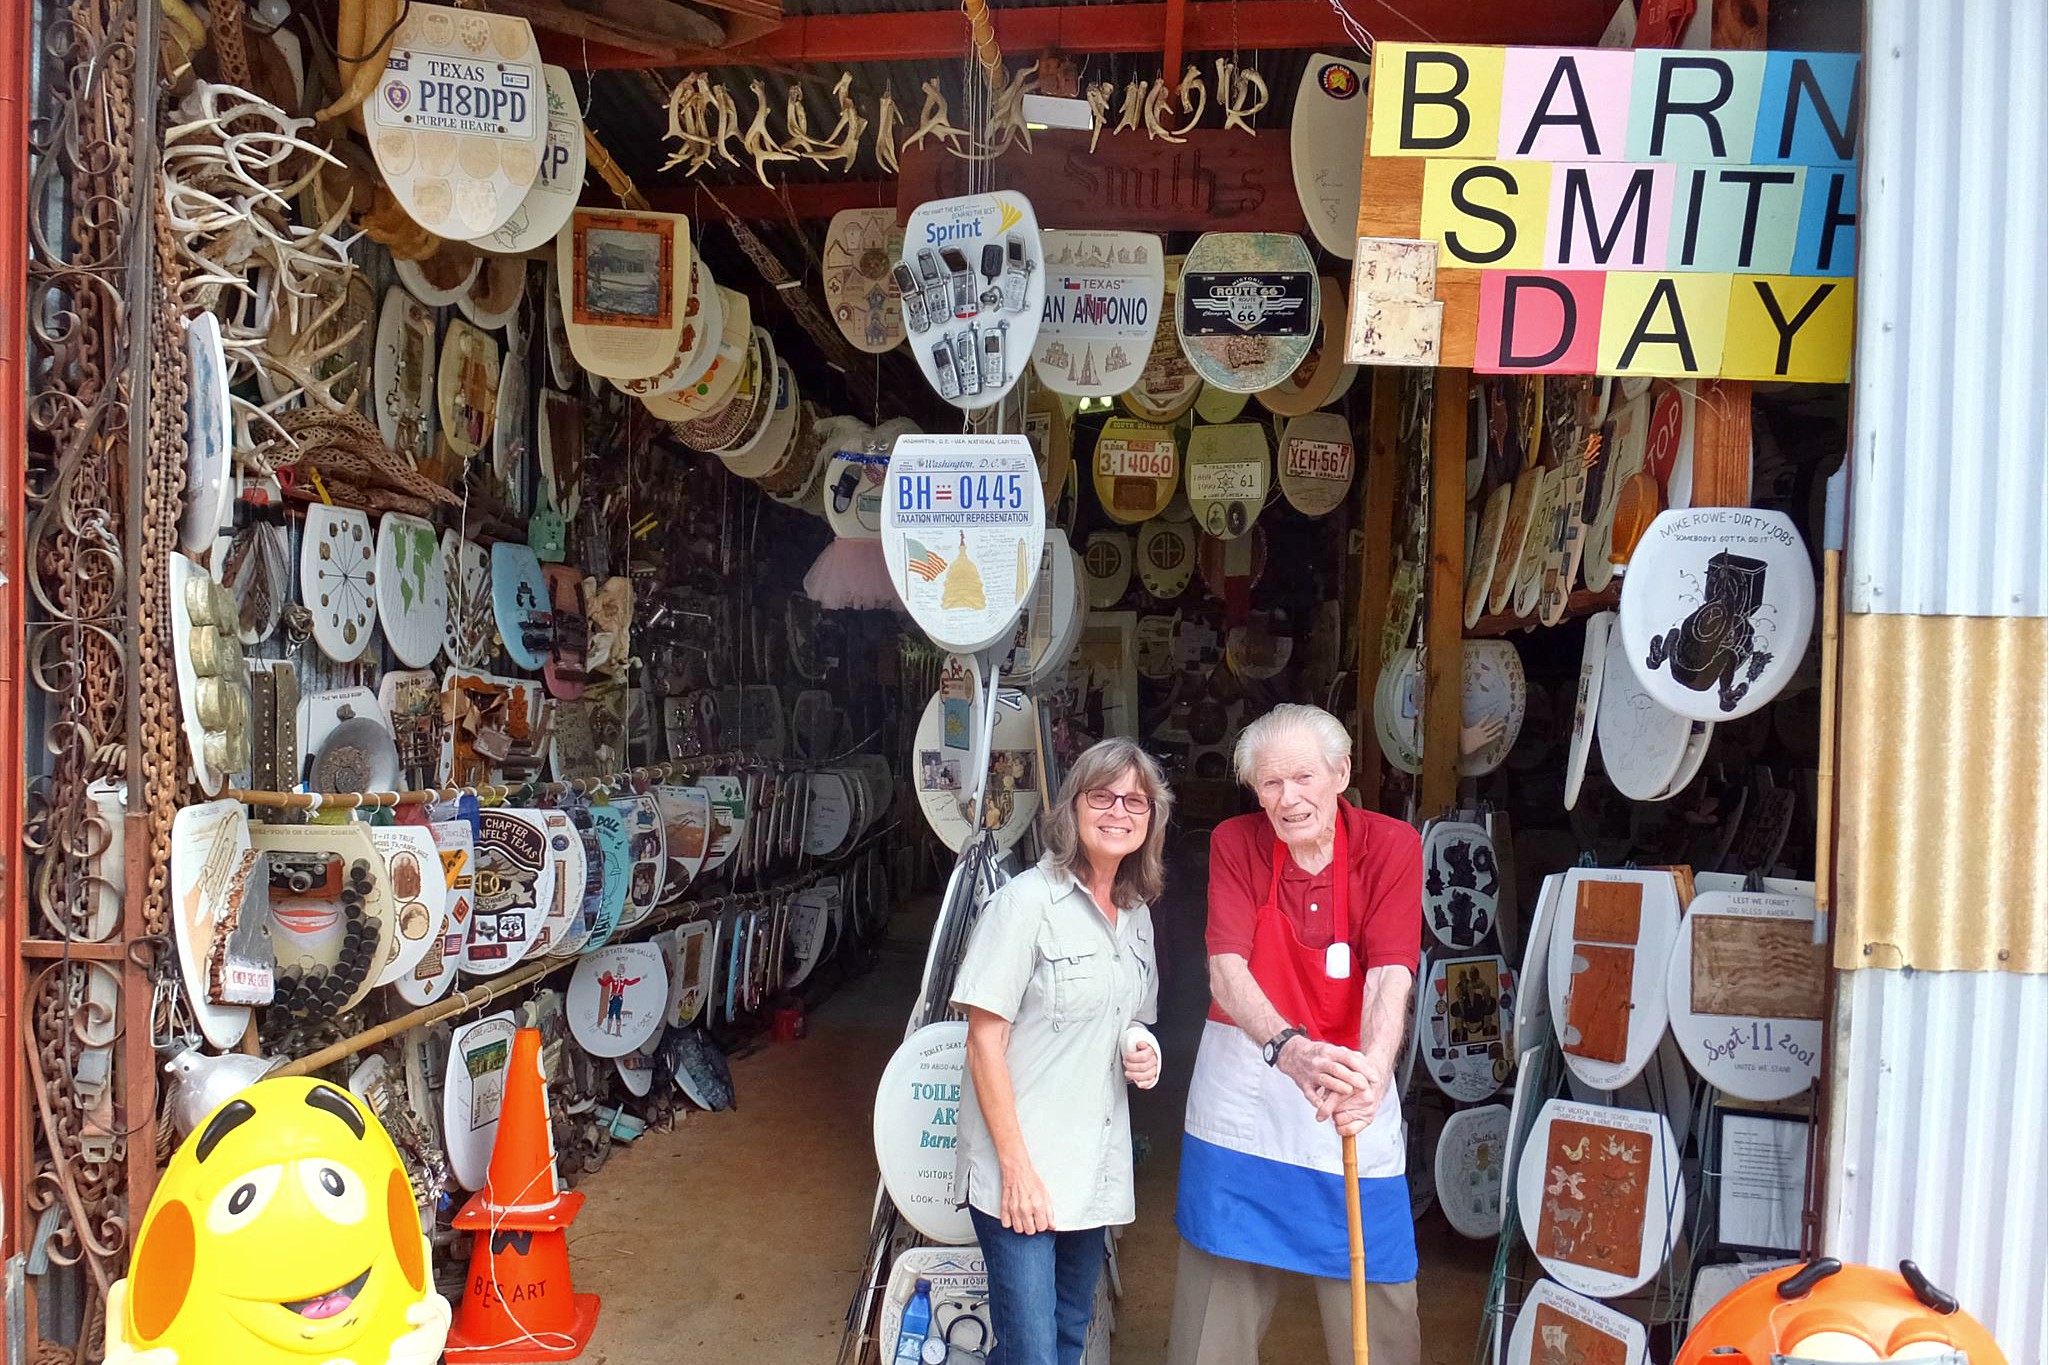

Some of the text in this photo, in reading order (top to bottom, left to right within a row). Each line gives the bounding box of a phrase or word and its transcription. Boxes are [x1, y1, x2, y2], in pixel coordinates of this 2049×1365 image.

[428, 60, 485, 82] TEXAS
[418, 80, 527, 123] PH8DPD
[1399, 50, 1861, 161] BARN
[415, 115, 498, 133] PURPLE HEART
[926, 217, 983, 246] Sprint
[1082, 279, 1121, 290] TEXAS
[1216, 286, 1278, 296] ROUTE 66
[1042, 295, 1148, 325] AN ANTONIO
[1237, 310, 1257, 322] 66
[1498, 275, 1836, 376] DAY
[1643, 401, 1679, 476] TOP
[925, 459, 975, 470] Washington,
[978, 458, 1000, 469] D.C.
[1240, 474, 1255, 488] 61
[899, 474, 1022, 510] BH 0445
[897, 513, 1029, 523] TAXATION WITHOUT REPRESENTATION
[1659, 517, 1690, 538] MIKE
[1767, 526, 1795, 546] JOBS
[485, 818, 529, 839] CHAPTER
[479, 829, 508, 841] NFELS
[510, 835, 538, 859] TEXAS
[1752, 897, 1762, 905] WE
[1741, 907, 1763, 915] BLESS
[1766, 909, 1795, 917] AMERICA
[501, 922, 520, 931] 46
[605, 947, 623, 957] STATE
[946, 1041, 962, 1050] SEAT
[1703, 1022, 1816, 1067] Sept. 11 2001
[1734, 1063, 1756, 1071] UNITED
[1771, 1065, 1791, 1073] STAND
[911, 1082, 960, 1102] TOILE
[931, 1107, 960, 1125] AR
[920, 1130, 957, 1149] Barne
[918, 1170, 953, 1180] VISITORS
[932, 1277, 986, 1286] CIMA HOSP
[512, 1280, 546, 1303] ART
